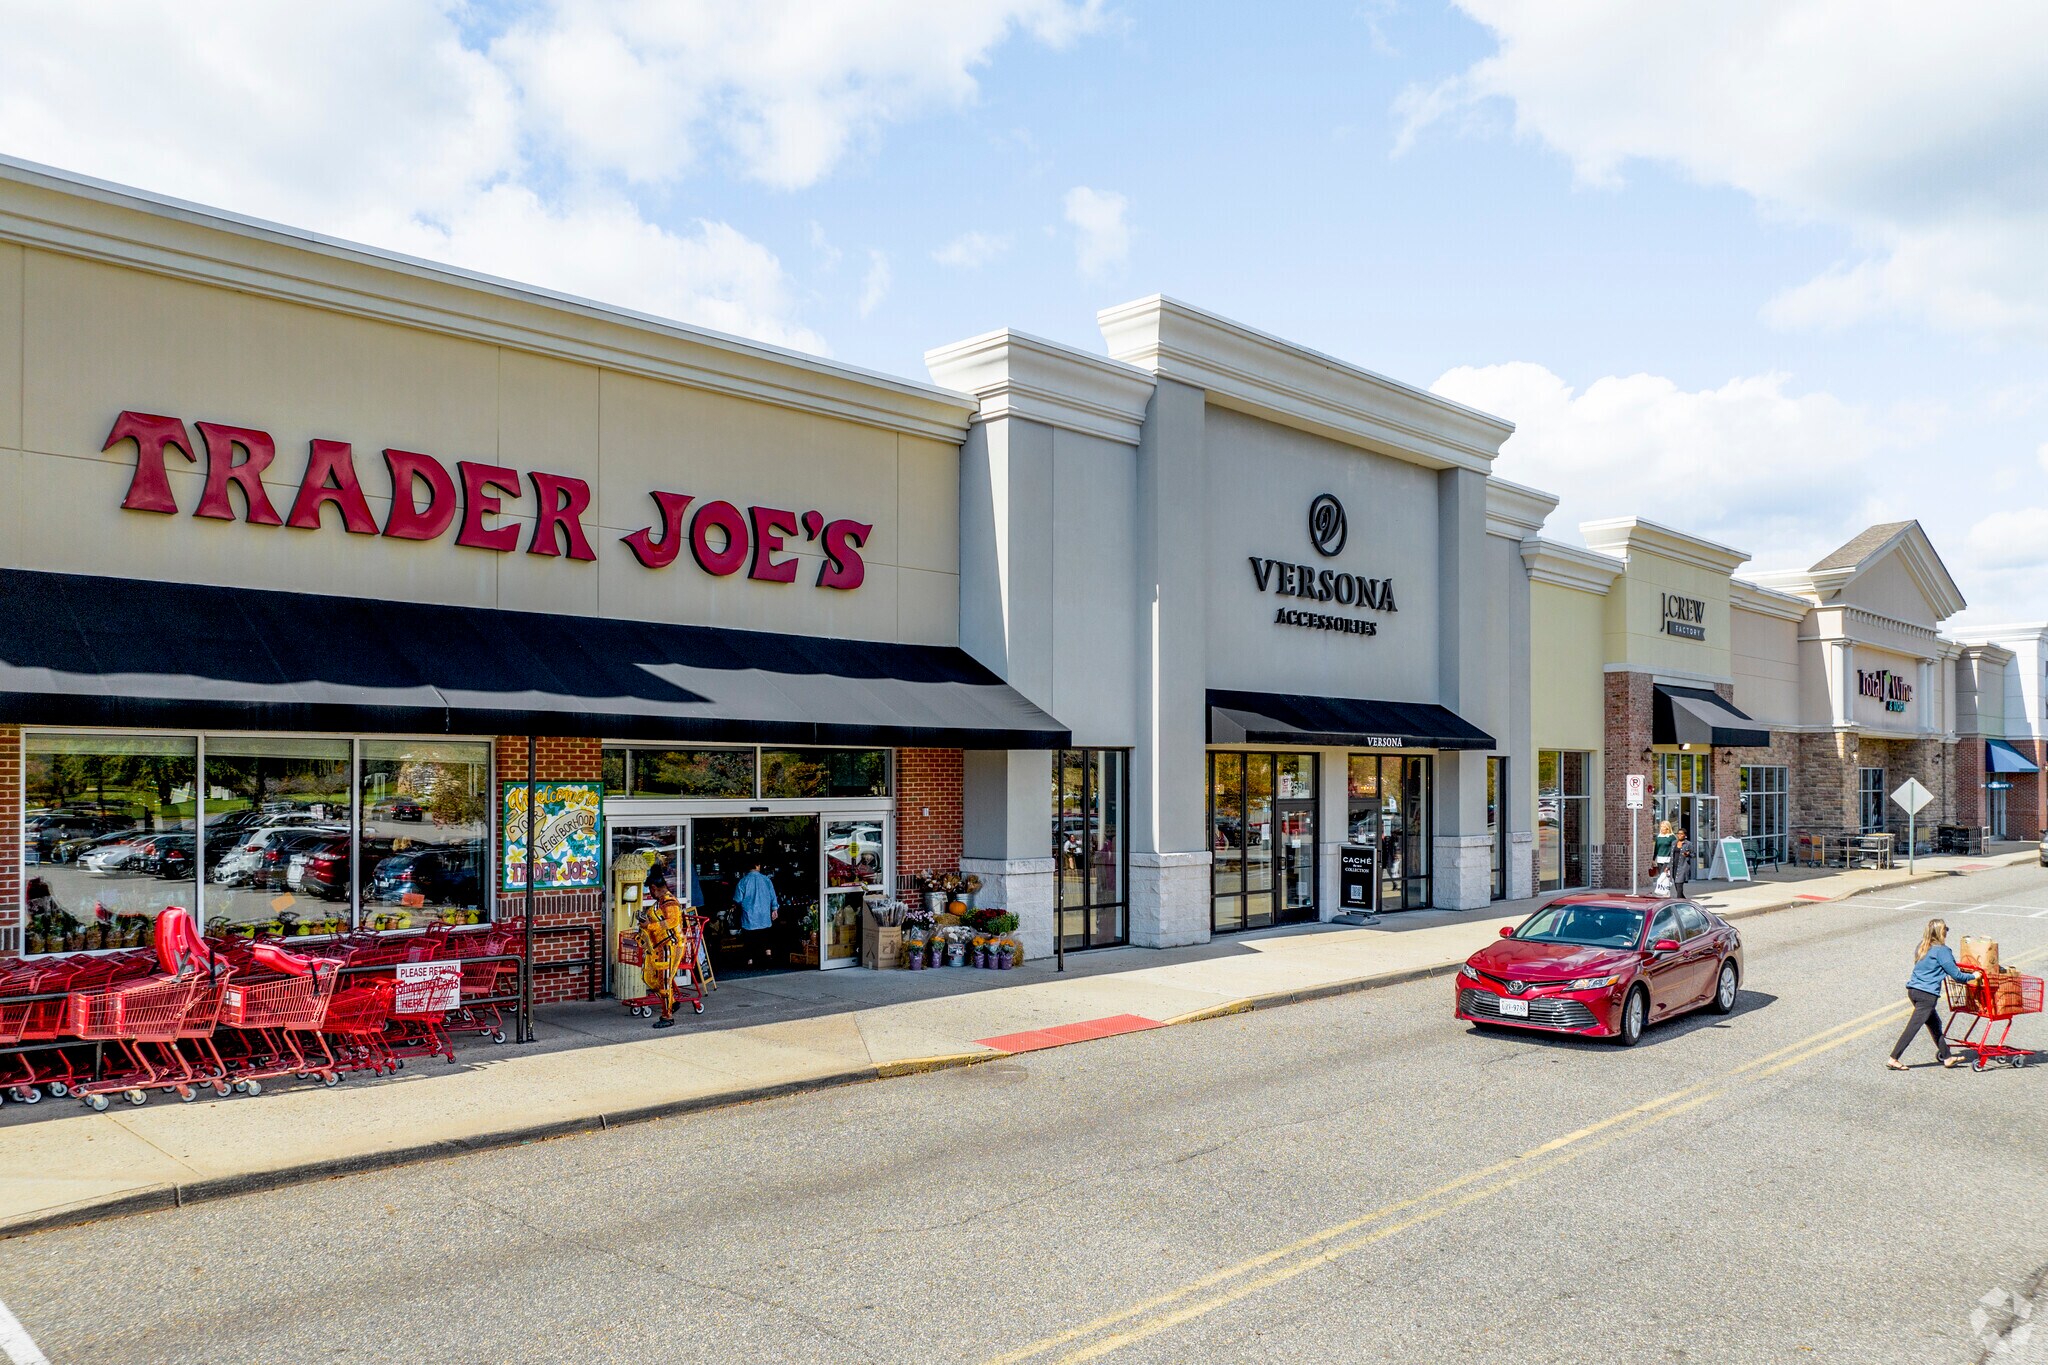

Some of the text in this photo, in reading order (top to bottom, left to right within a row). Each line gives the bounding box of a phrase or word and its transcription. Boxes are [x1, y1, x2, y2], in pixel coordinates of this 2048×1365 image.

[101, 410, 873, 590] TRADER JOE'S
[1248, 556, 1398, 612] VERSONA
[1274, 607, 1377, 636] ACCESSORIES
[1660, 592, 1705, 632] J.CREW
[1675, 625, 1701, 636] FACTORY
[1857, 669, 1884, 702] Total
[1367, 736, 1402, 747] VERSONA
[510, 811, 543, 833] YOR
[1342, 856, 1372, 865] CACHÉ
[511, 862, 558, 882] TRDER
[401, 967, 427, 978] PLEASE
